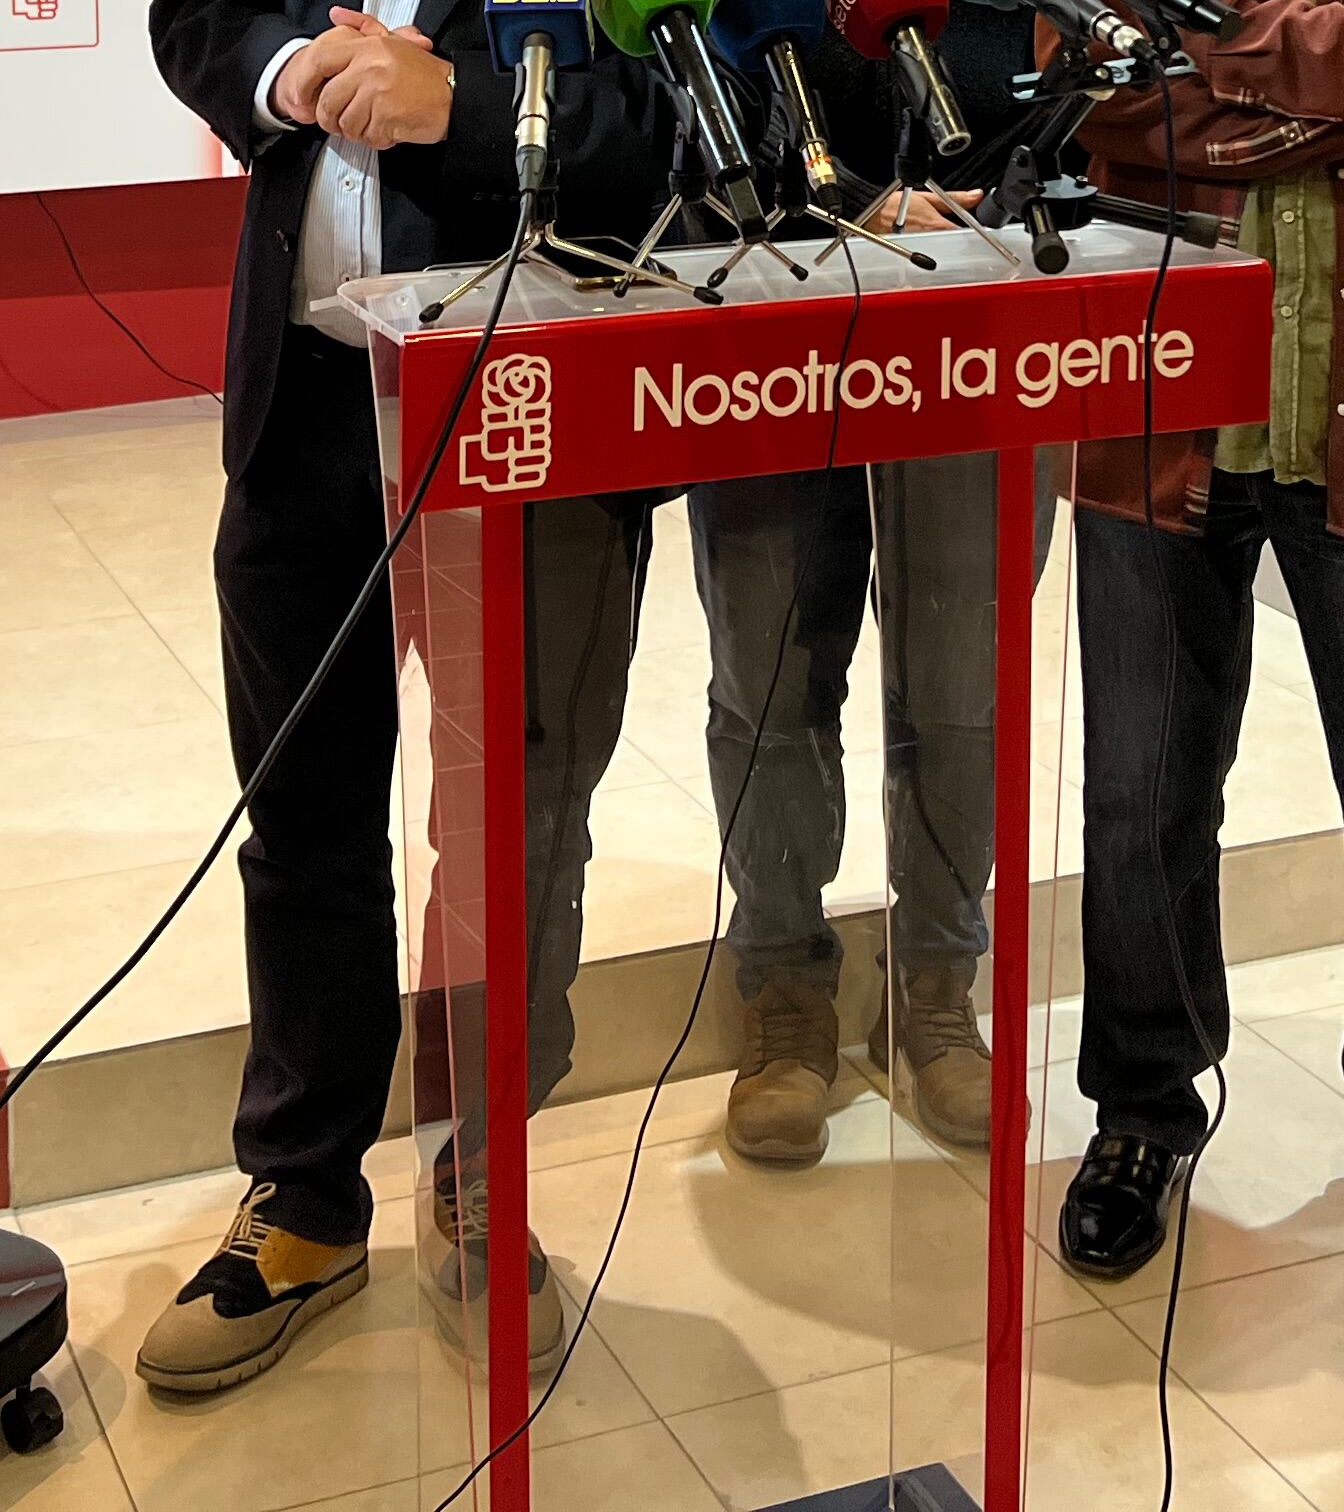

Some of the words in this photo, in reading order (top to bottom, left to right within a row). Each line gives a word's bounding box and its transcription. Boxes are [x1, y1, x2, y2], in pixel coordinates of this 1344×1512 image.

[633, 348, 922, 433] Nosotros,
[940, 336, 997, 400] la
[1015, 319, 1196, 409] gente
